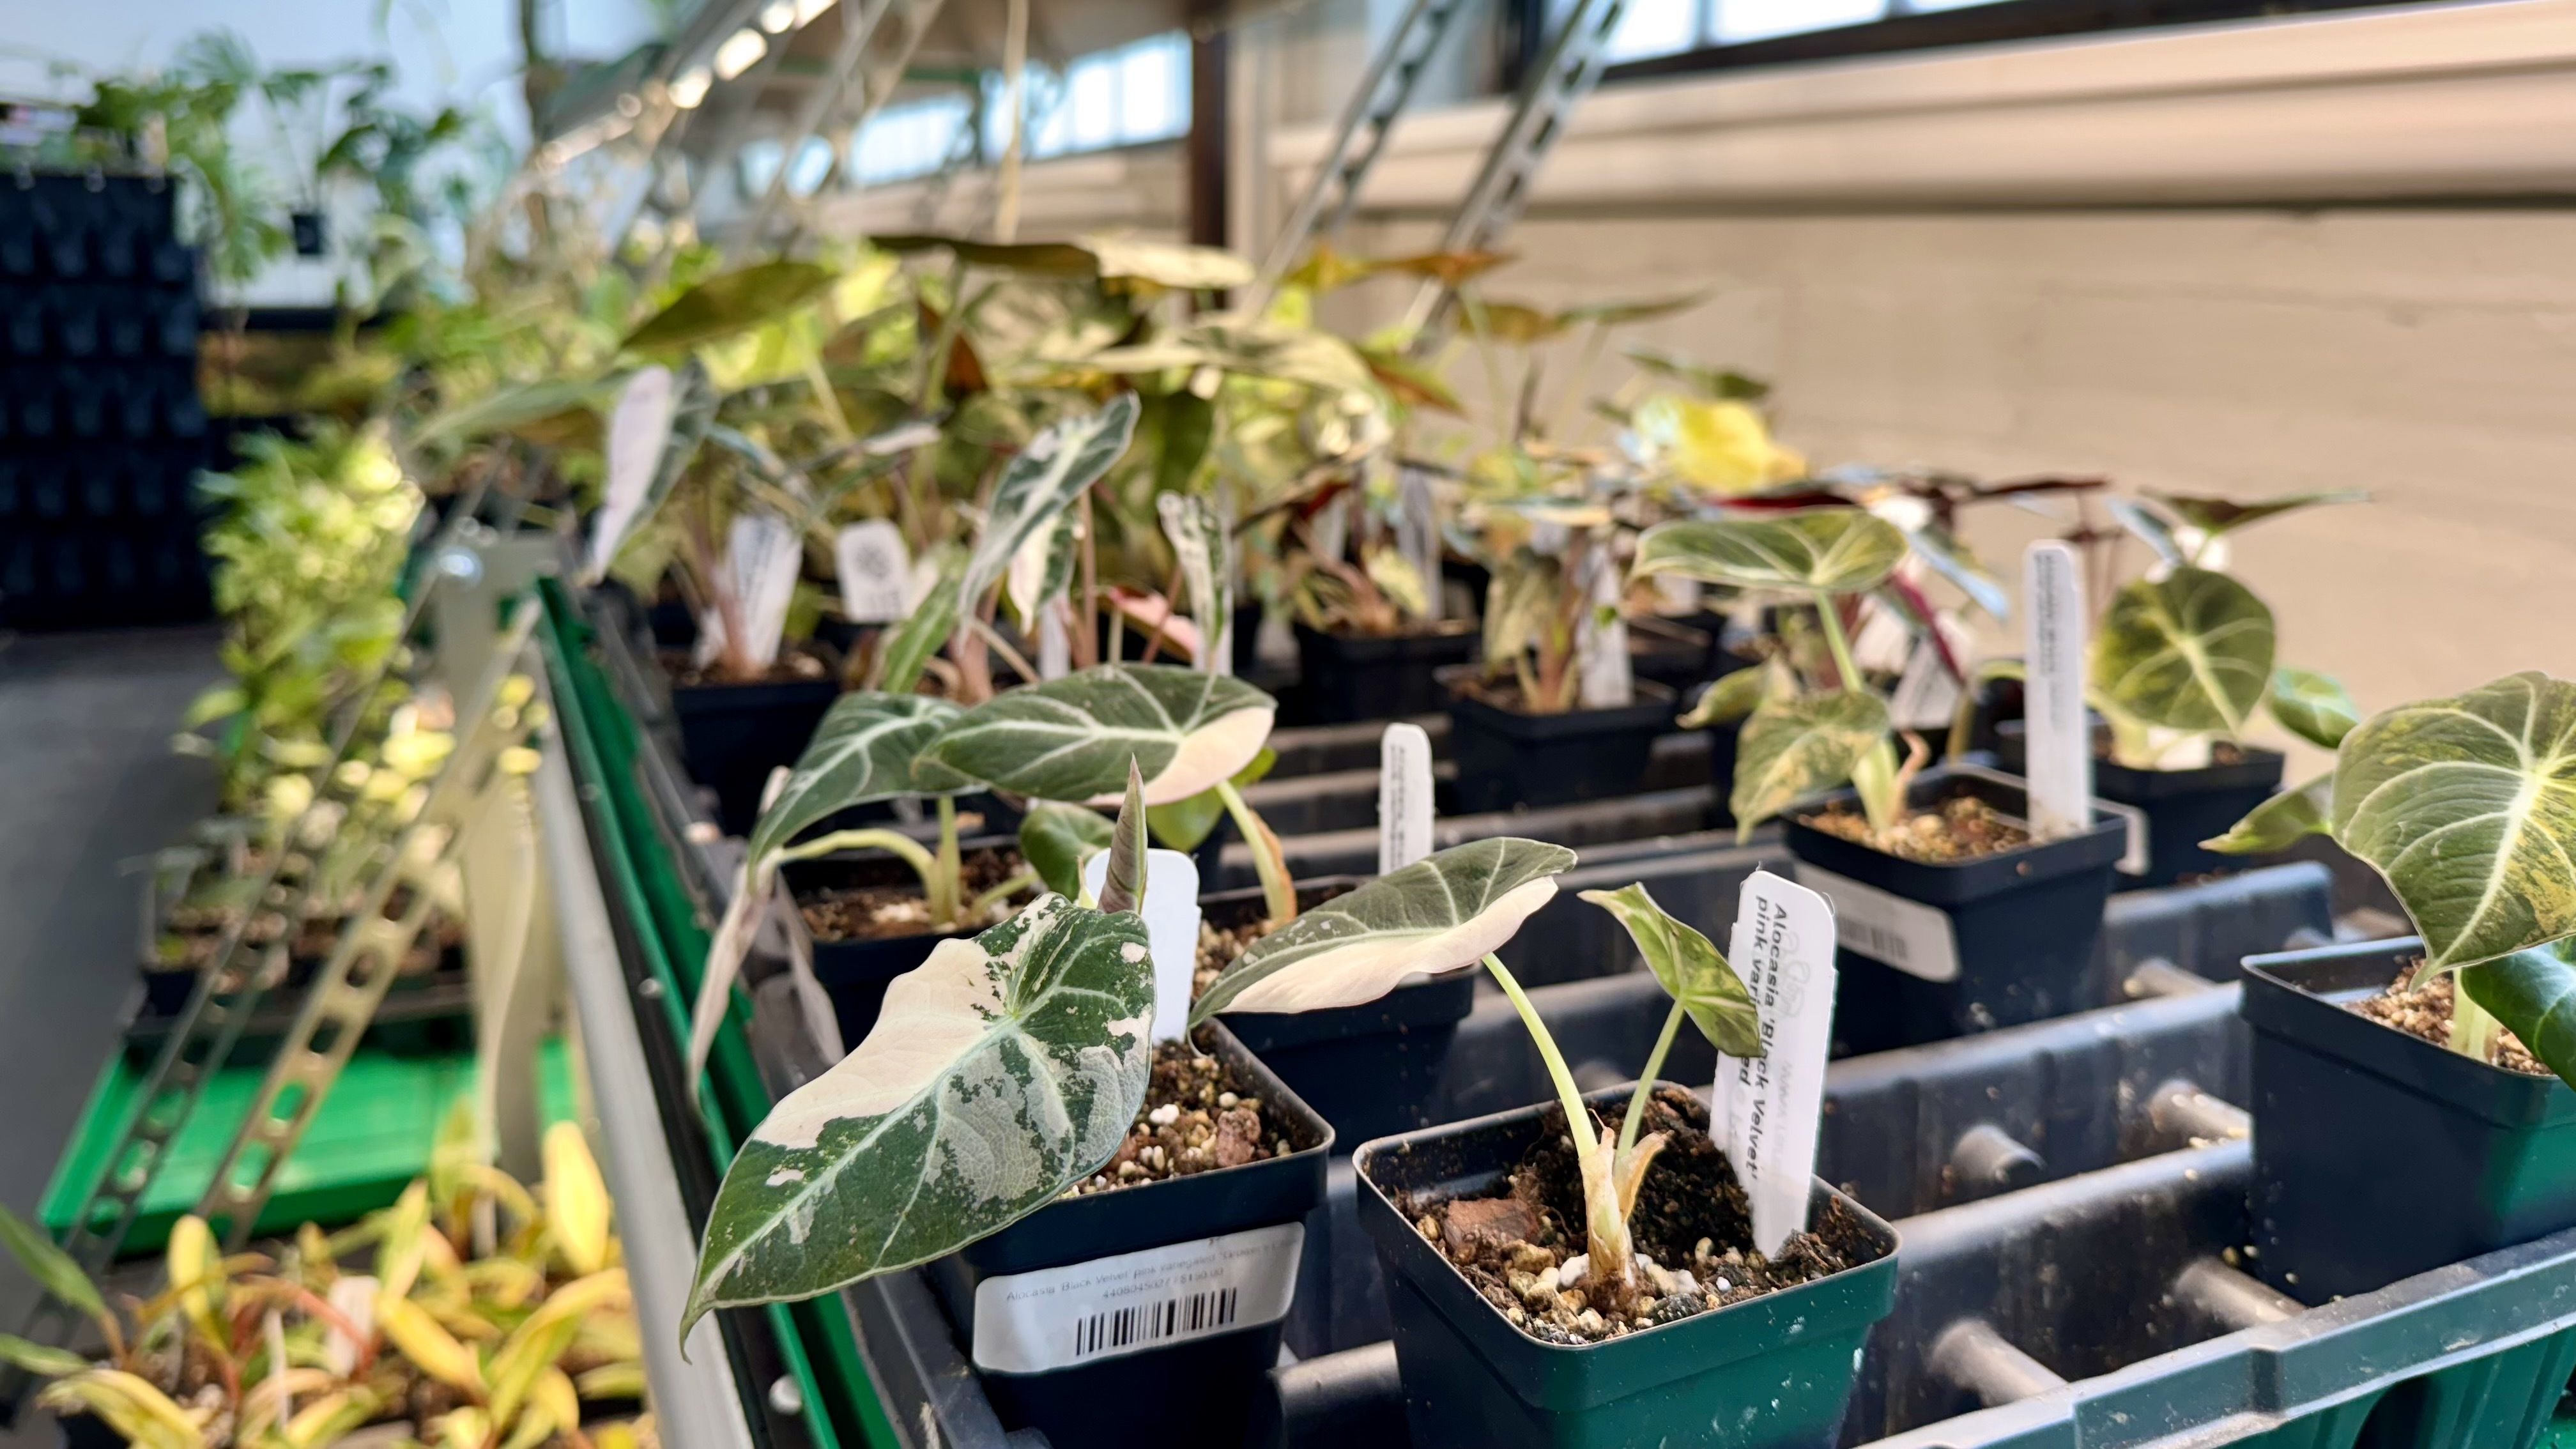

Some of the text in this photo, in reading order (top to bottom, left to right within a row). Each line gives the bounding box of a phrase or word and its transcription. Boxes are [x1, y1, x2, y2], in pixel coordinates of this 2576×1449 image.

[1754, 895, 1770, 951] pink
[1765, 903, 1788, 1007] Alocasia
[1745, 1099, 1765, 1180] Velvet'
[1006, 1285, 1055, 1301] Alocasia
